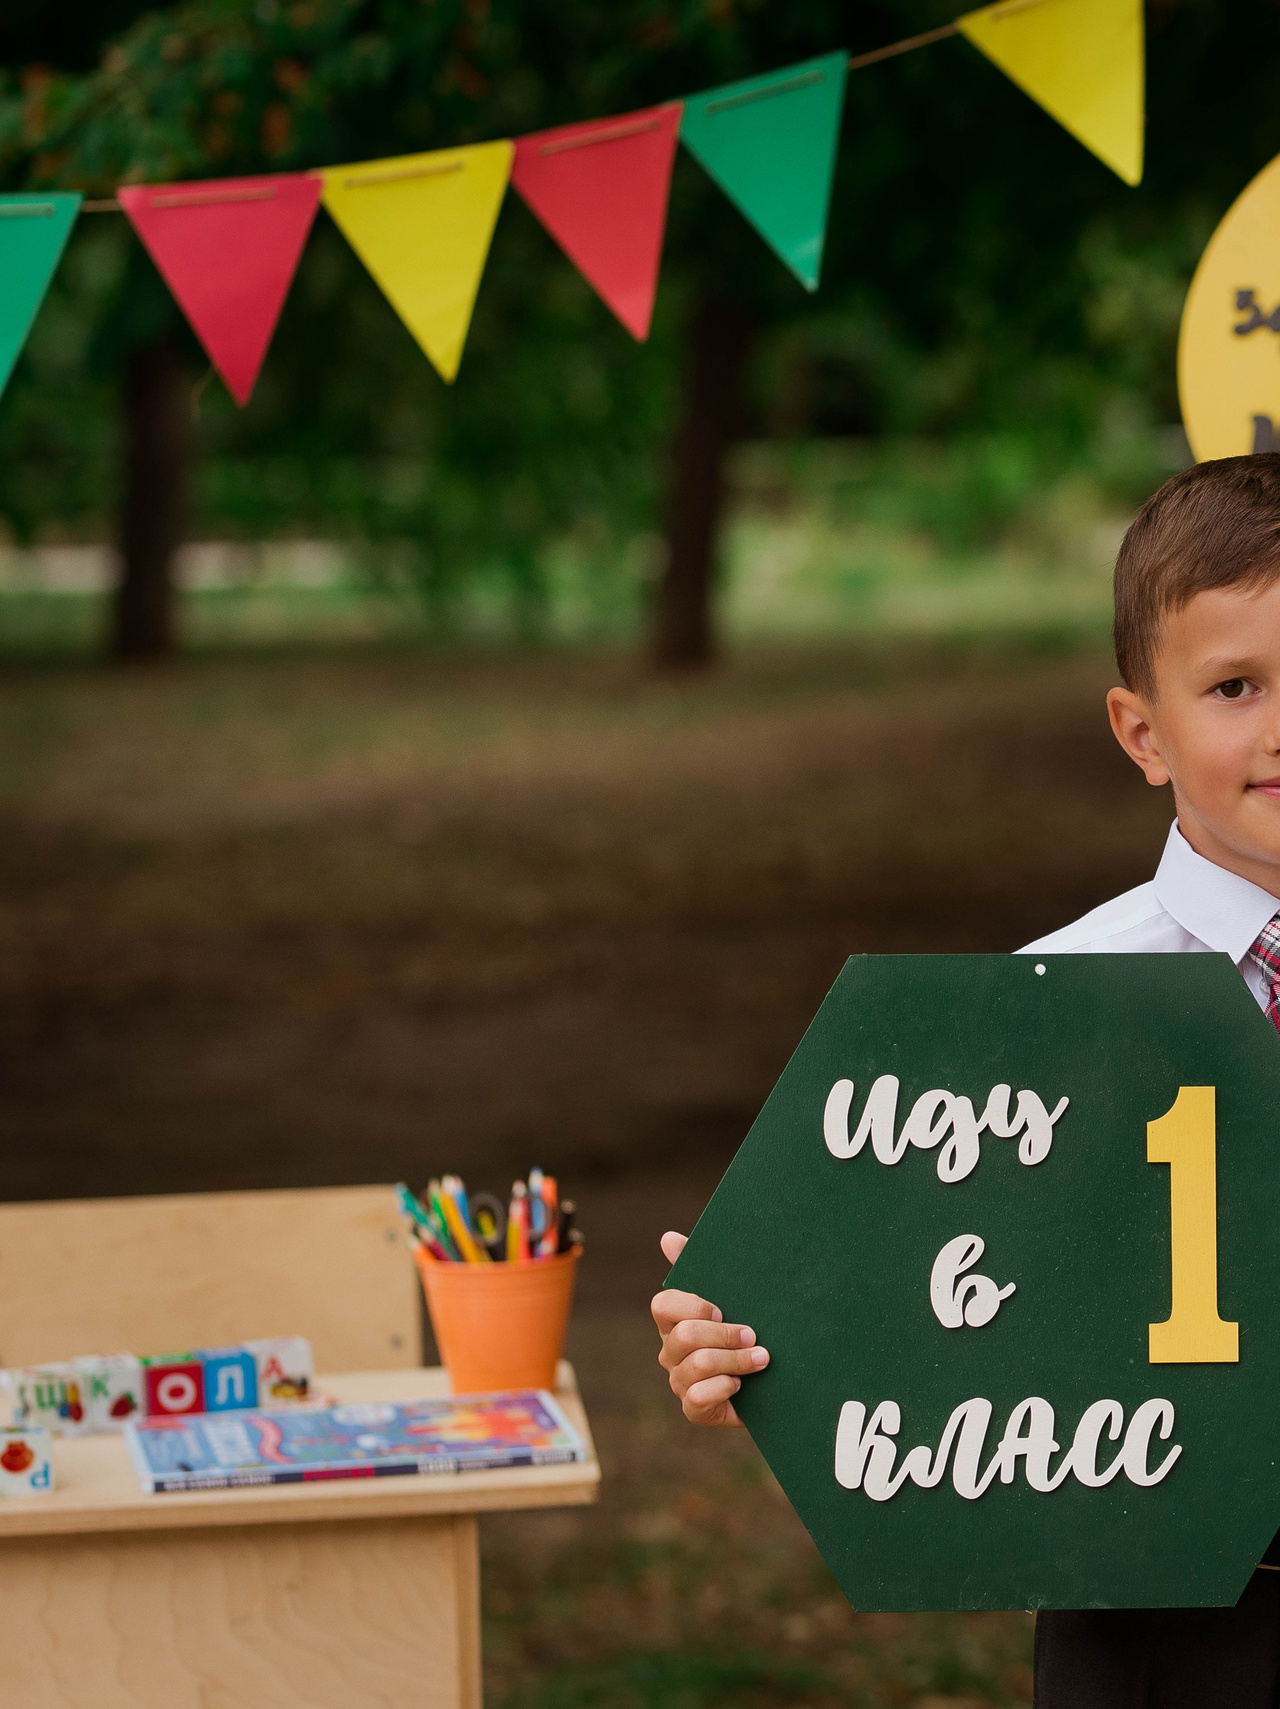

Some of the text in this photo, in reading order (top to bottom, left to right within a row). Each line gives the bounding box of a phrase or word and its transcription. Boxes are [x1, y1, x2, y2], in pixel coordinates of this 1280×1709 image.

[823, 1074, 1070, 1184] Иду
[1146, 1085, 1240, 1364] 1
[834, 1396, 1183, 1502] КЛАСС
